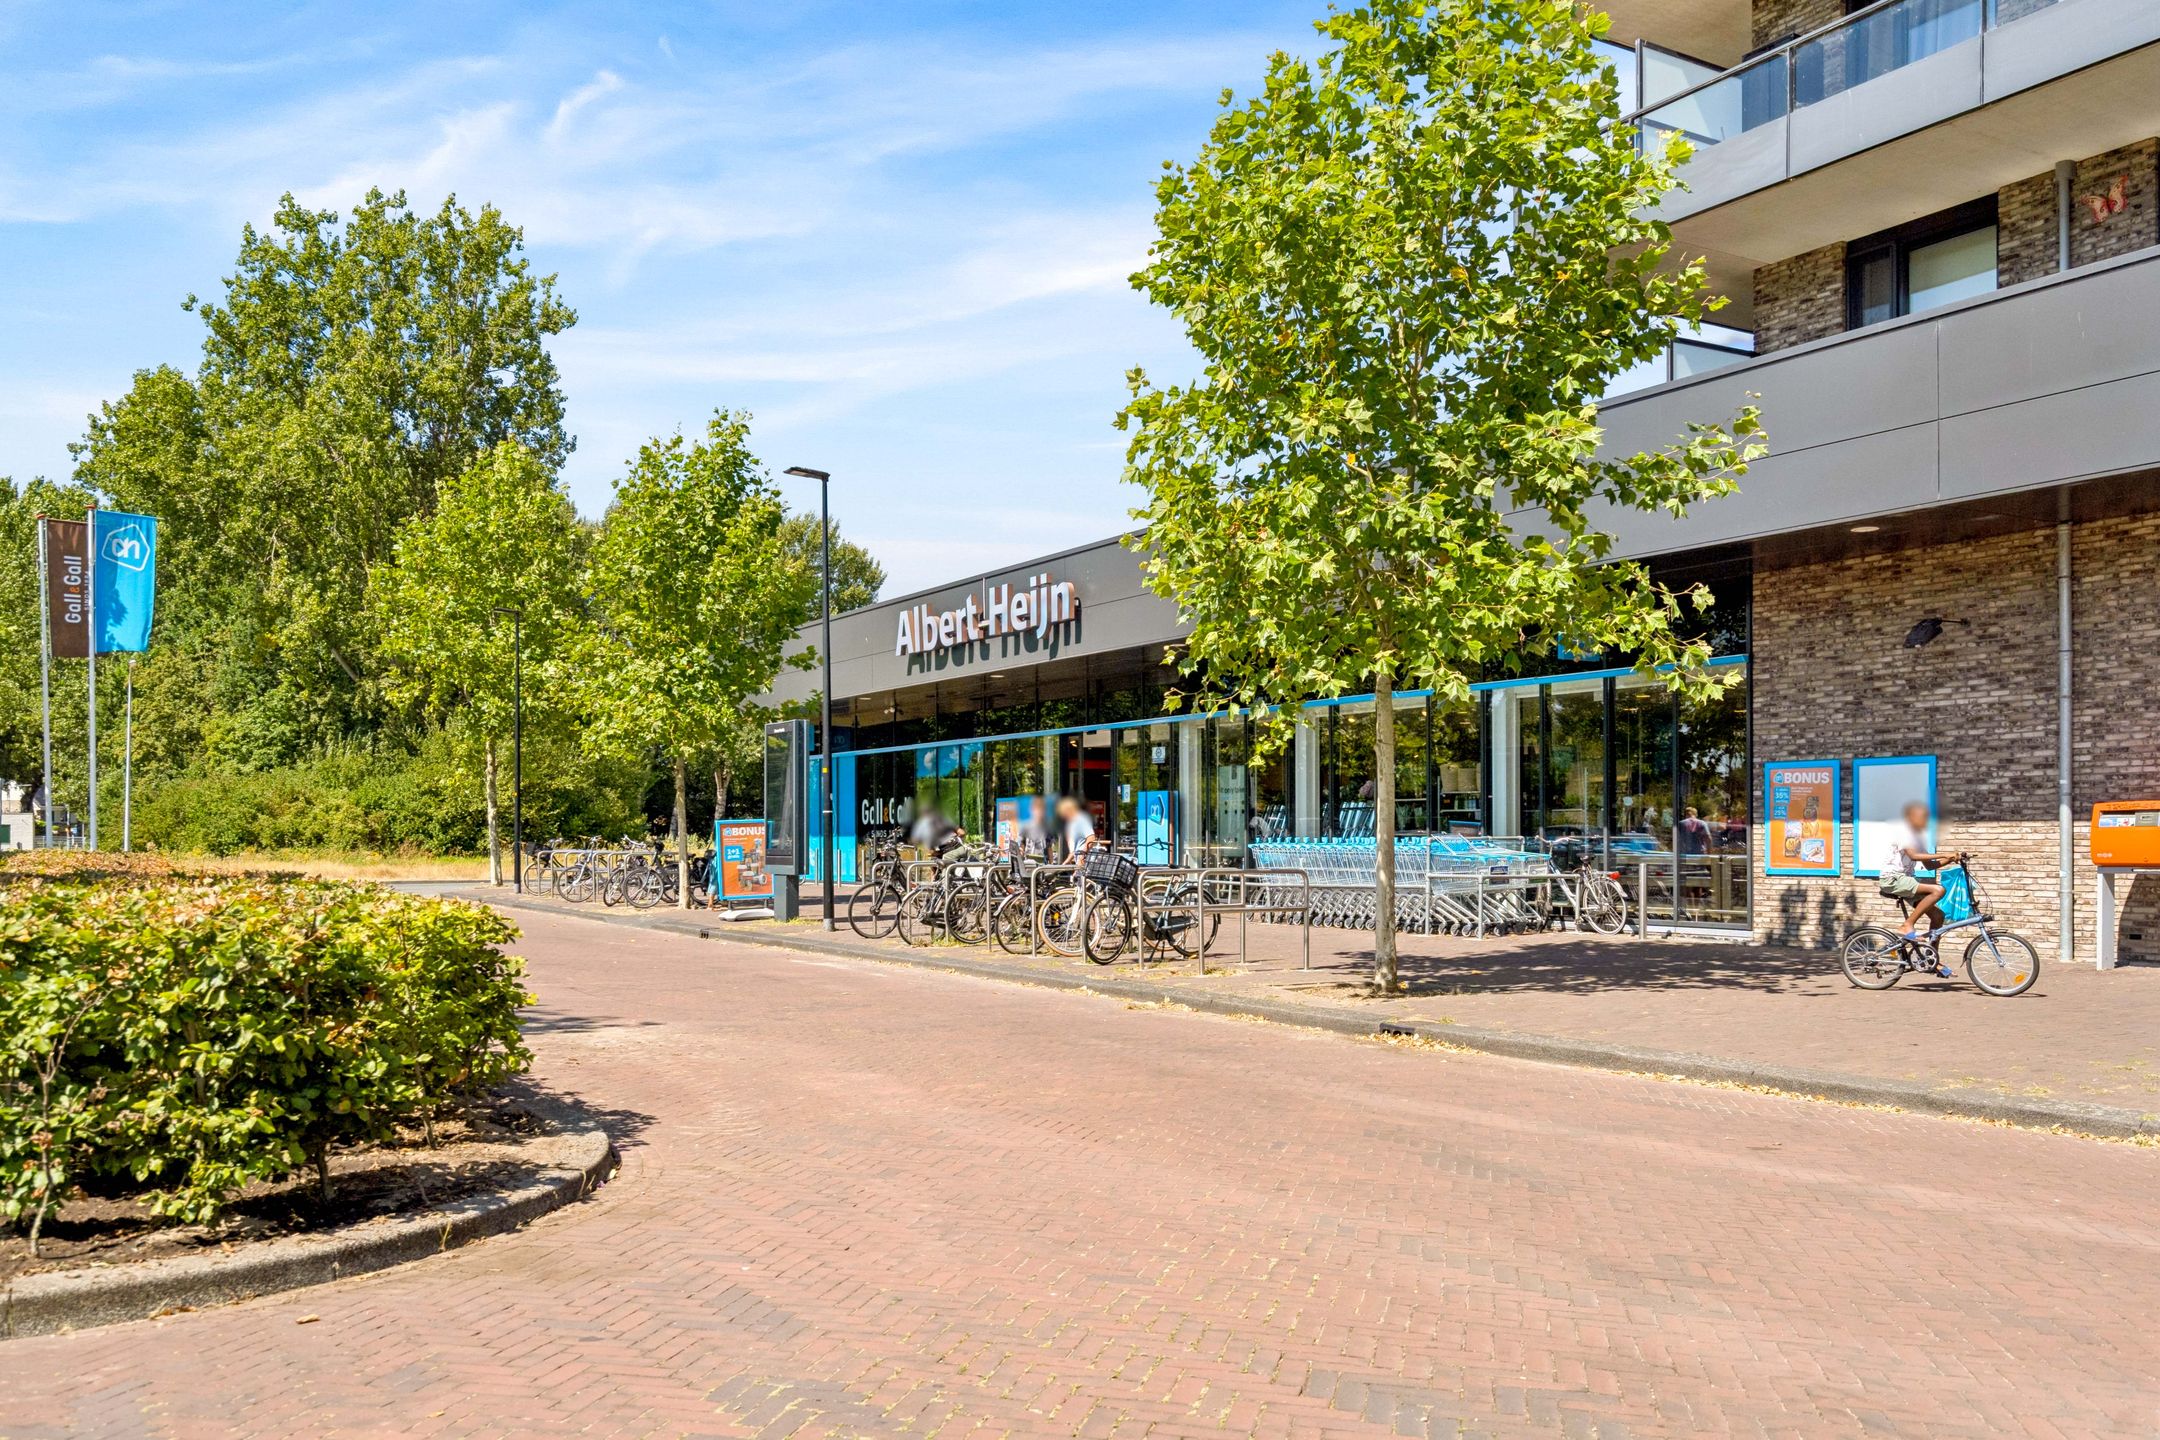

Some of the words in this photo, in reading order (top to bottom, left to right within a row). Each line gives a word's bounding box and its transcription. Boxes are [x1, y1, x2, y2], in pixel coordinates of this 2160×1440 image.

[63, 555, 82, 586] Gall
[63, 593, 82, 624] Gall
[895, 593, 980, 657] Albert
[988, 573, 1071, 640] Heijn
[1784, 771, 1830, 784] BONUS
[861, 797, 883, 825] Gall
[889, 796, 913, 826] Ga
[871, 829, 887, 838] SNDS
